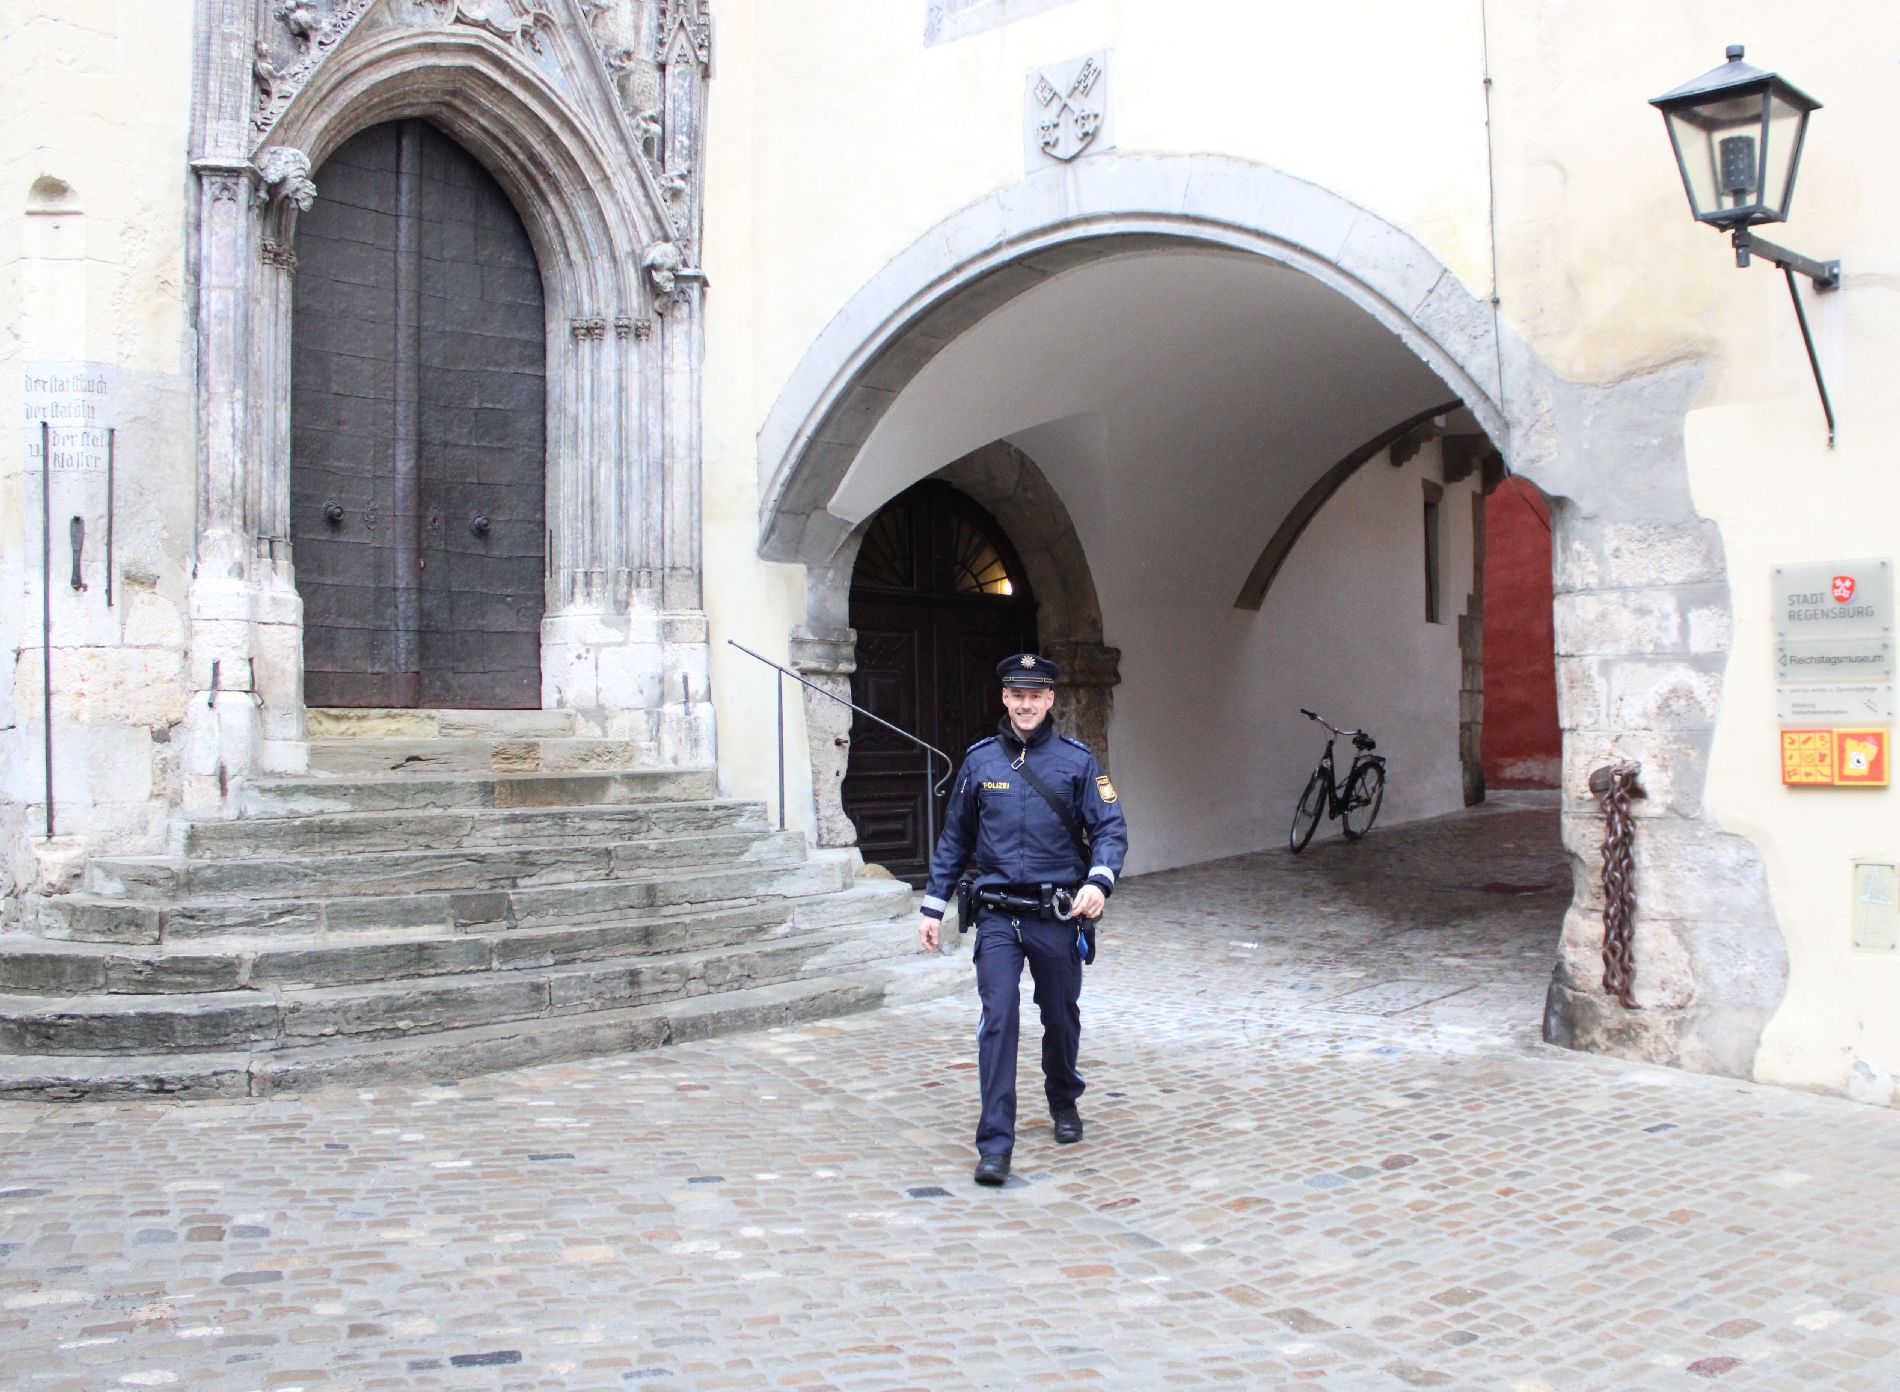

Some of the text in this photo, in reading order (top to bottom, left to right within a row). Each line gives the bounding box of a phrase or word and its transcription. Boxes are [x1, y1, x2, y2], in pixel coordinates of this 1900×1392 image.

[1788, 592, 1825, 606] STADT
[1788, 605, 1874, 621] REGENSBURG
[1789, 655, 1884, 665] Reichstagsmuseum
[983, 781, 1010, 789] POLIZEI
